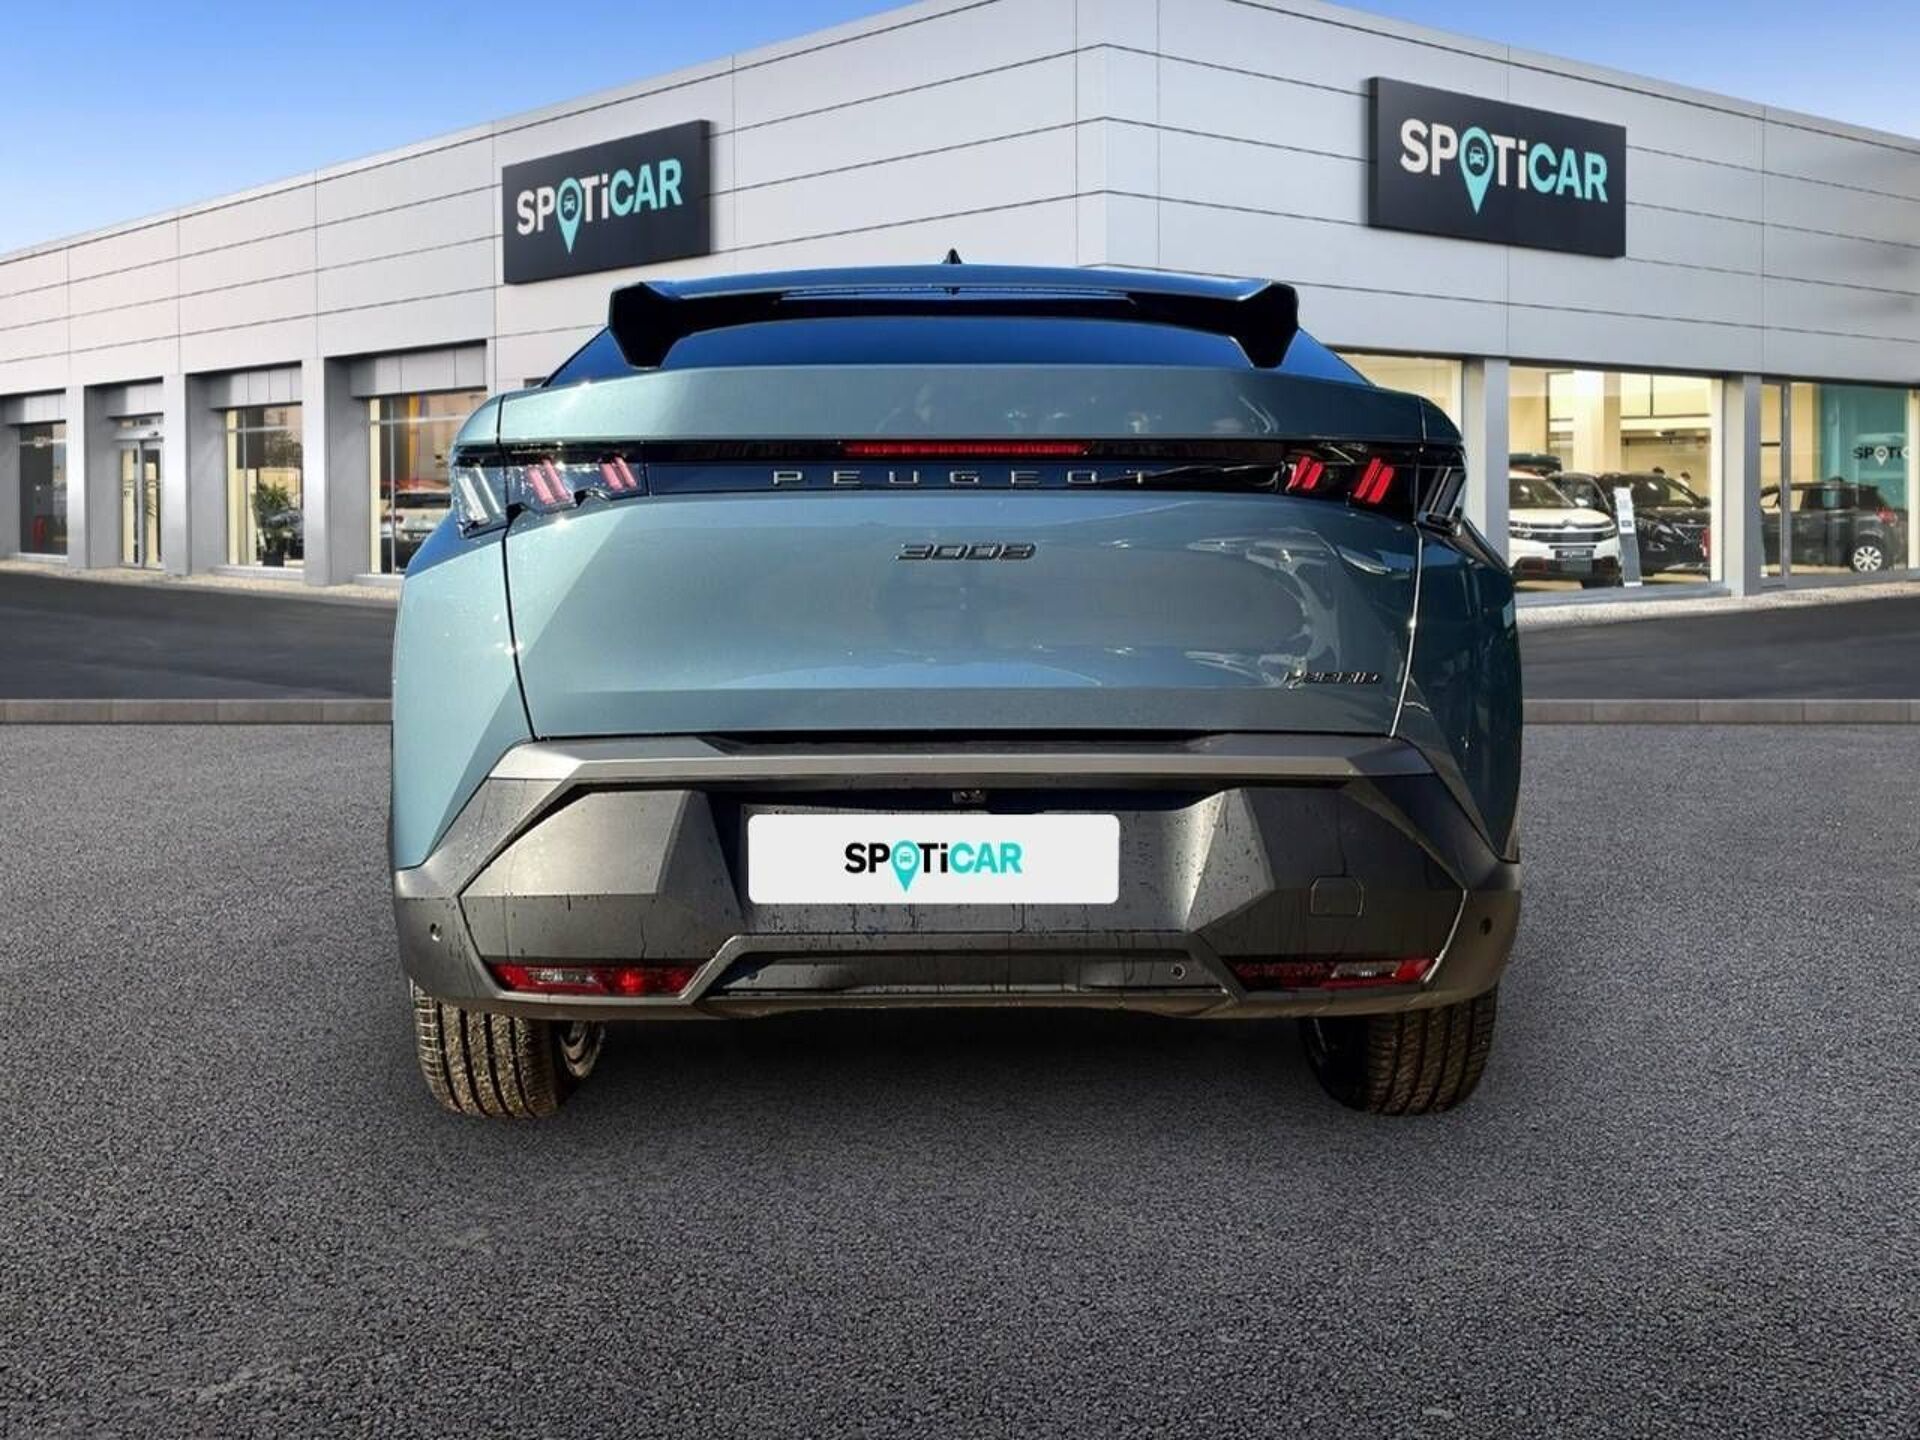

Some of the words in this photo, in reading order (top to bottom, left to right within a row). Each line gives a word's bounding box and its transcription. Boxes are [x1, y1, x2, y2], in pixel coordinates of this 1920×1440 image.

[1400, 118, 1609, 215] SPOTiCAR
[516, 157, 683, 253] SPOTiCAR
[773, 469, 1151, 485] PEUGEOT
[896, 542, 1037, 560] 3008
[844, 840, 1023, 891] SPOTiCAR
